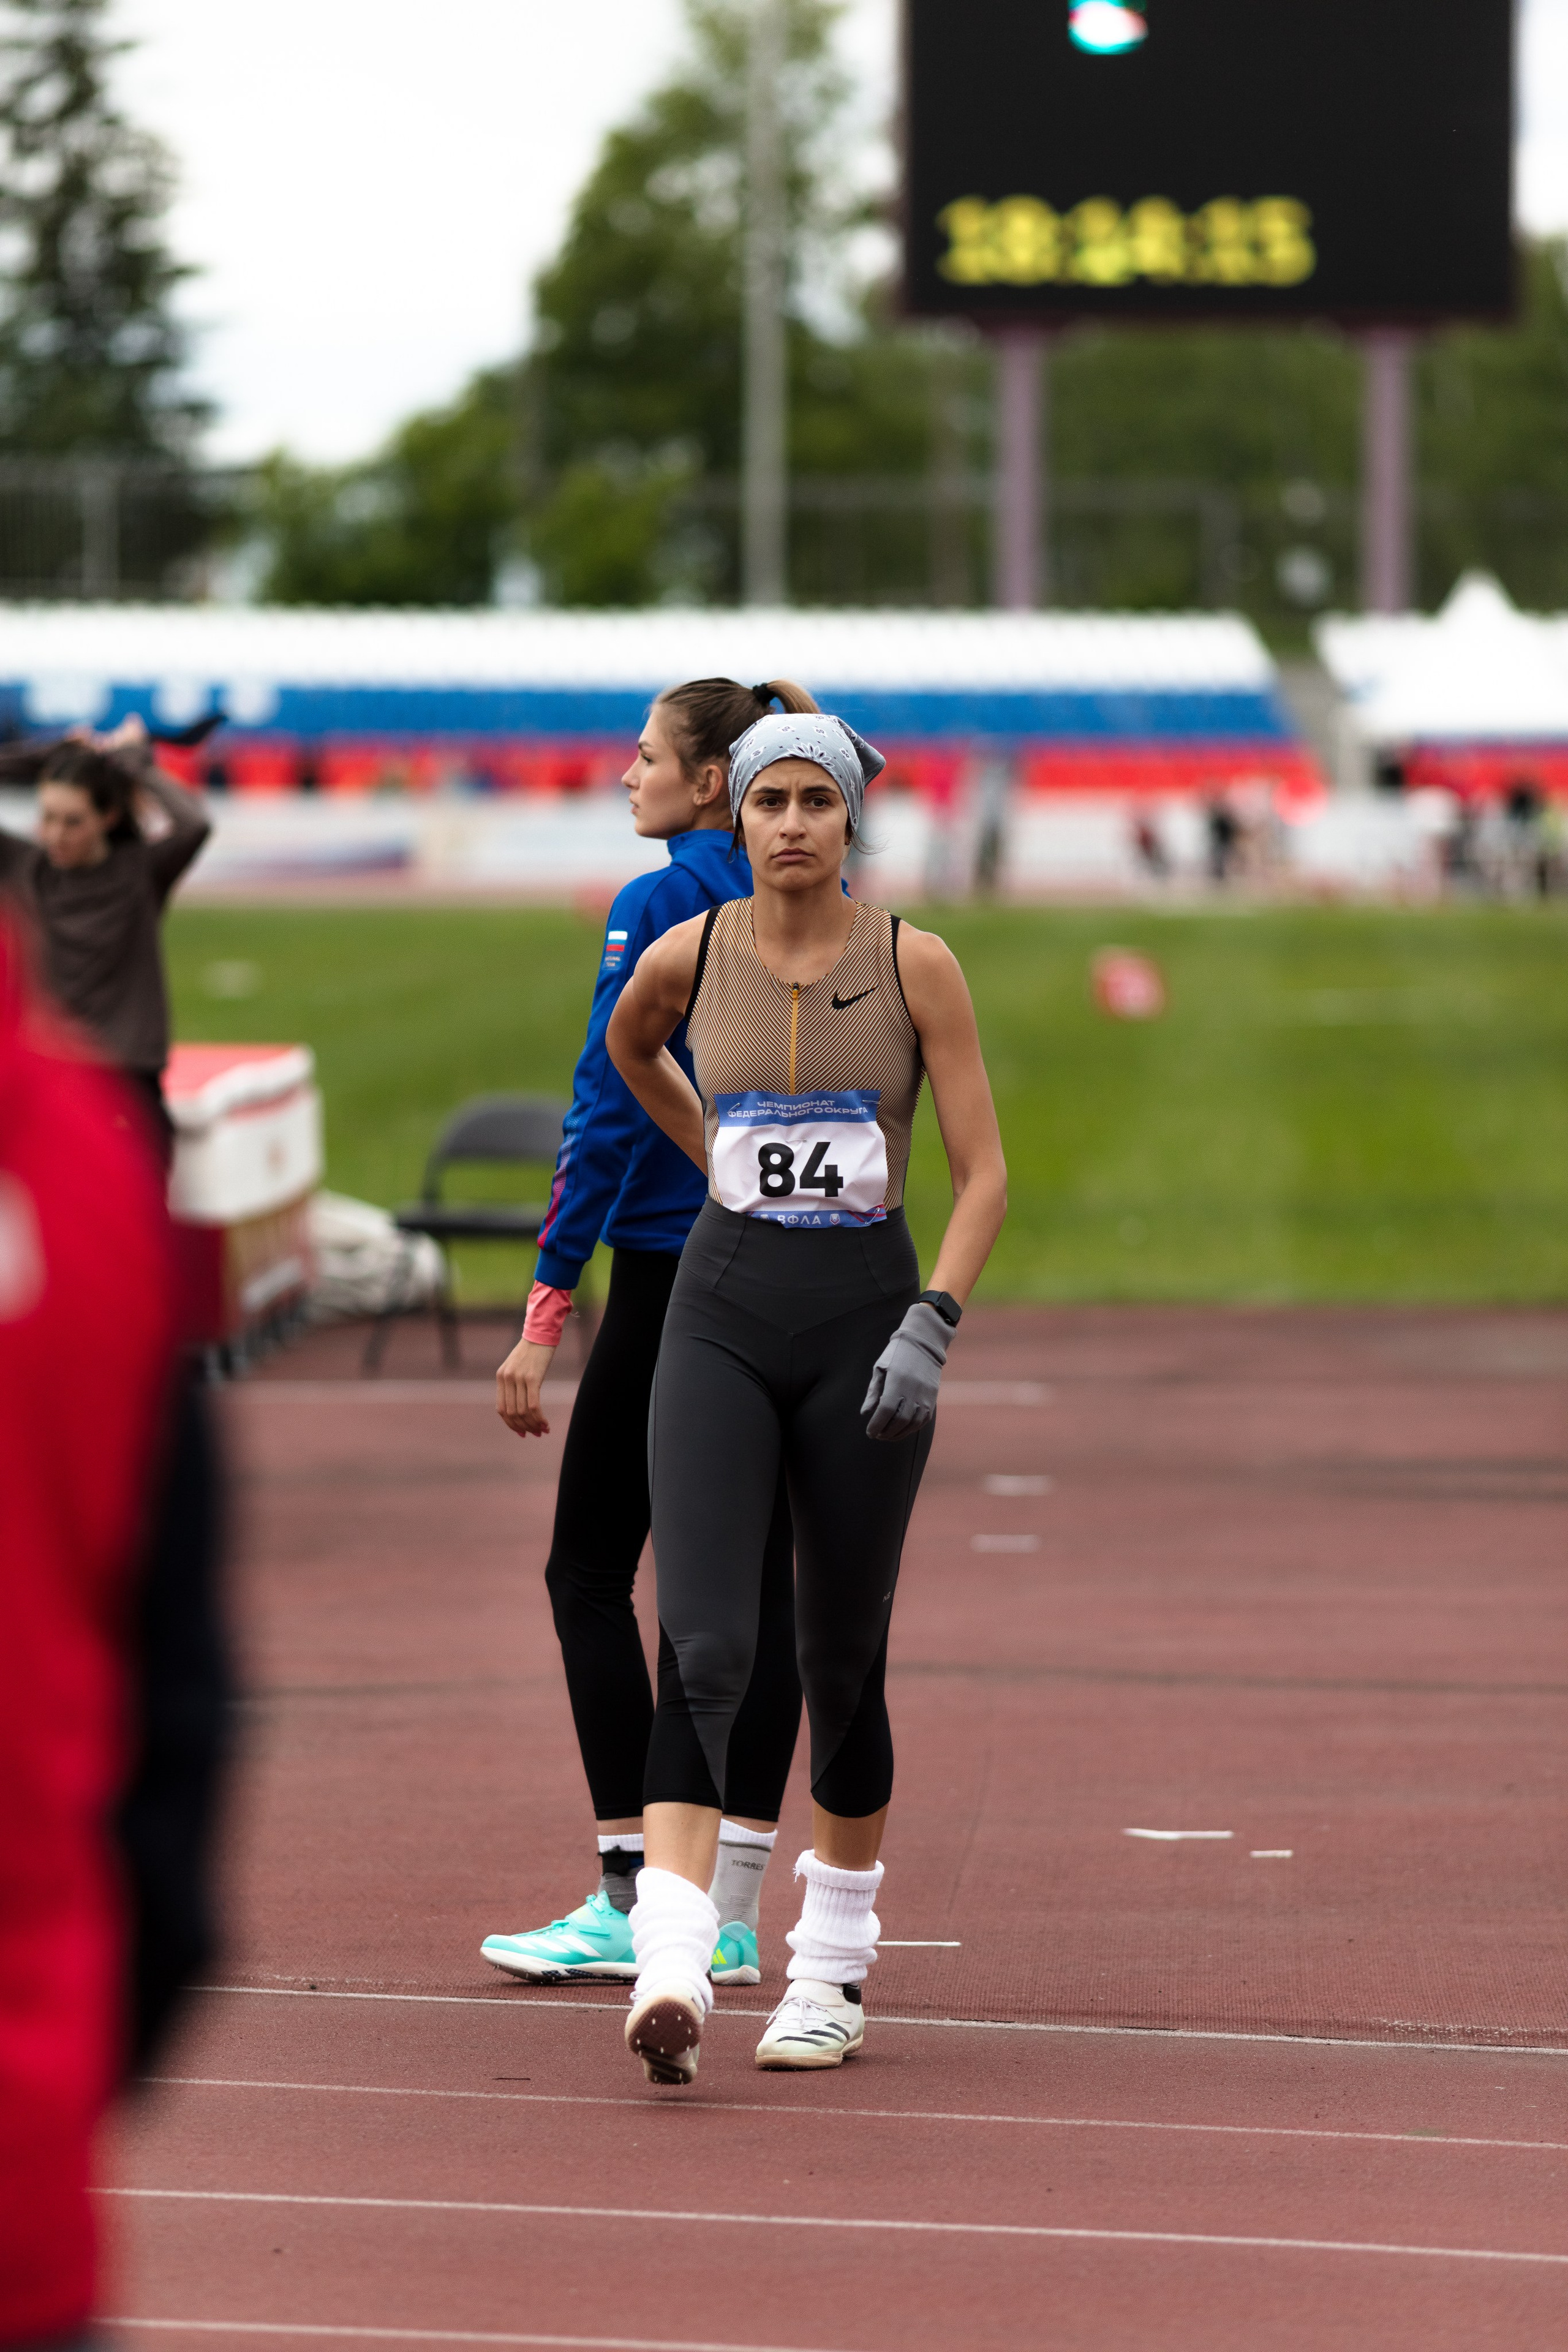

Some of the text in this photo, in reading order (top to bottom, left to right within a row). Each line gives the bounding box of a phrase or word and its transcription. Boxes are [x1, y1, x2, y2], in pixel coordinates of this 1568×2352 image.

[757, 1100, 835, 1110] ЧЕМПИОНАТ
[758, 1142, 843, 1197] 84
[777, 1215, 821, 1224] ВФЛА
[731, 1860, 764, 1870] TORRES
